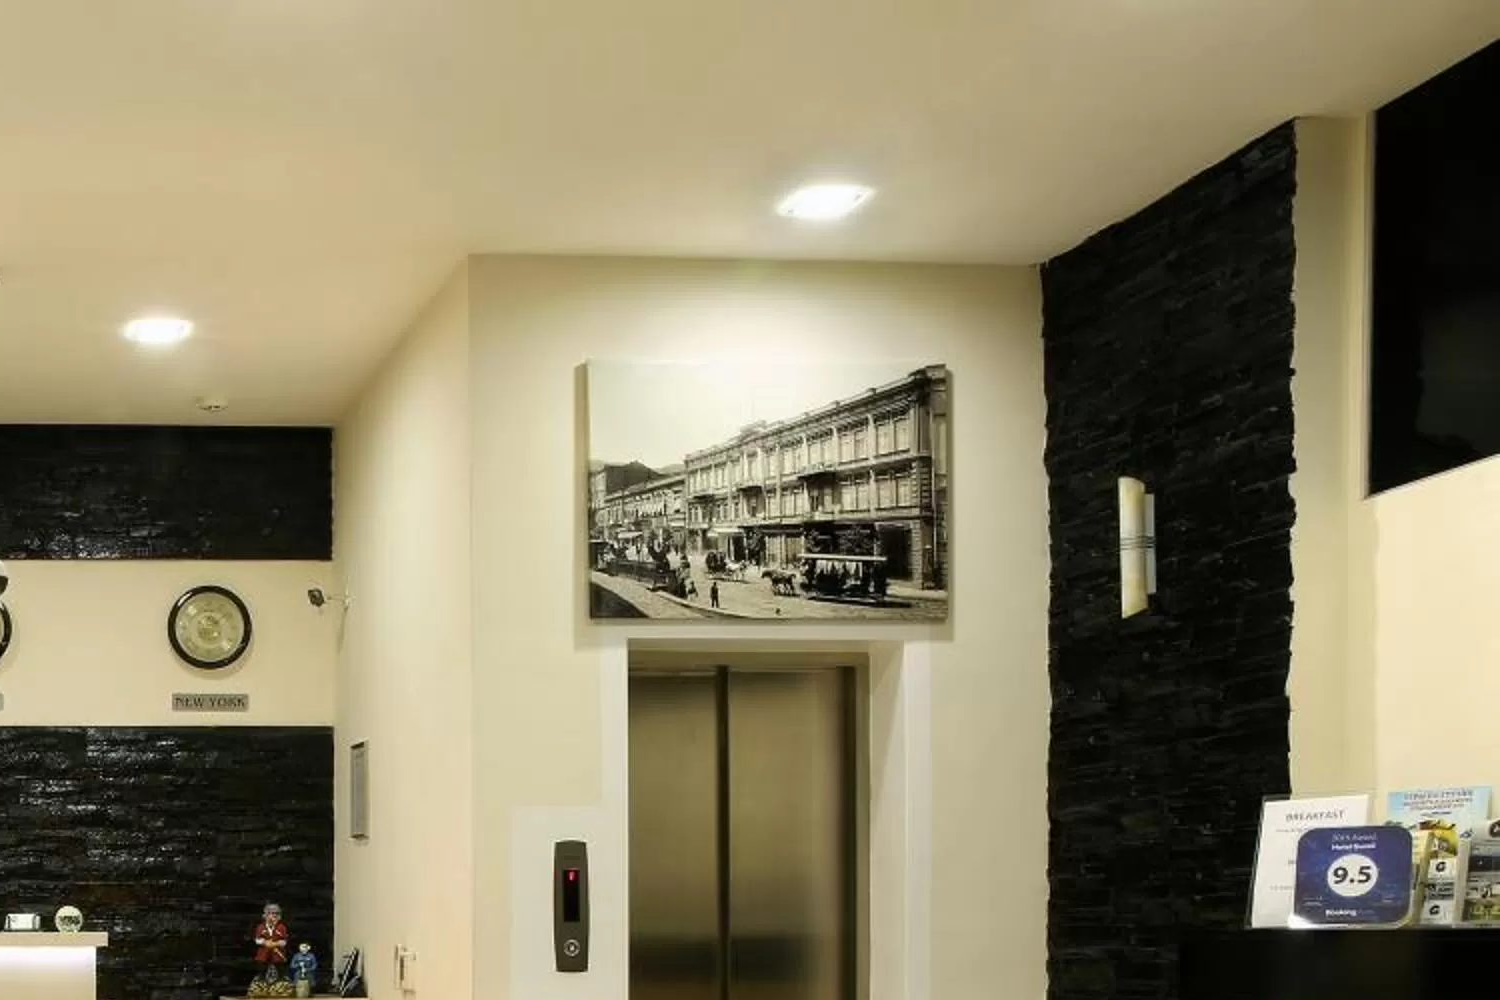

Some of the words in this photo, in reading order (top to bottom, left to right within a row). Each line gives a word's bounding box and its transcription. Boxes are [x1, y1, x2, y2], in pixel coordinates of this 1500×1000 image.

[175, 696, 205, 708] NEW
[209, 696, 245, 708] YORK
[1285, 809, 1345, 822] BREAKFAST
[1332, 865, 1372, 885] 9.5
[1325, 908, 1376, 917] Booking
